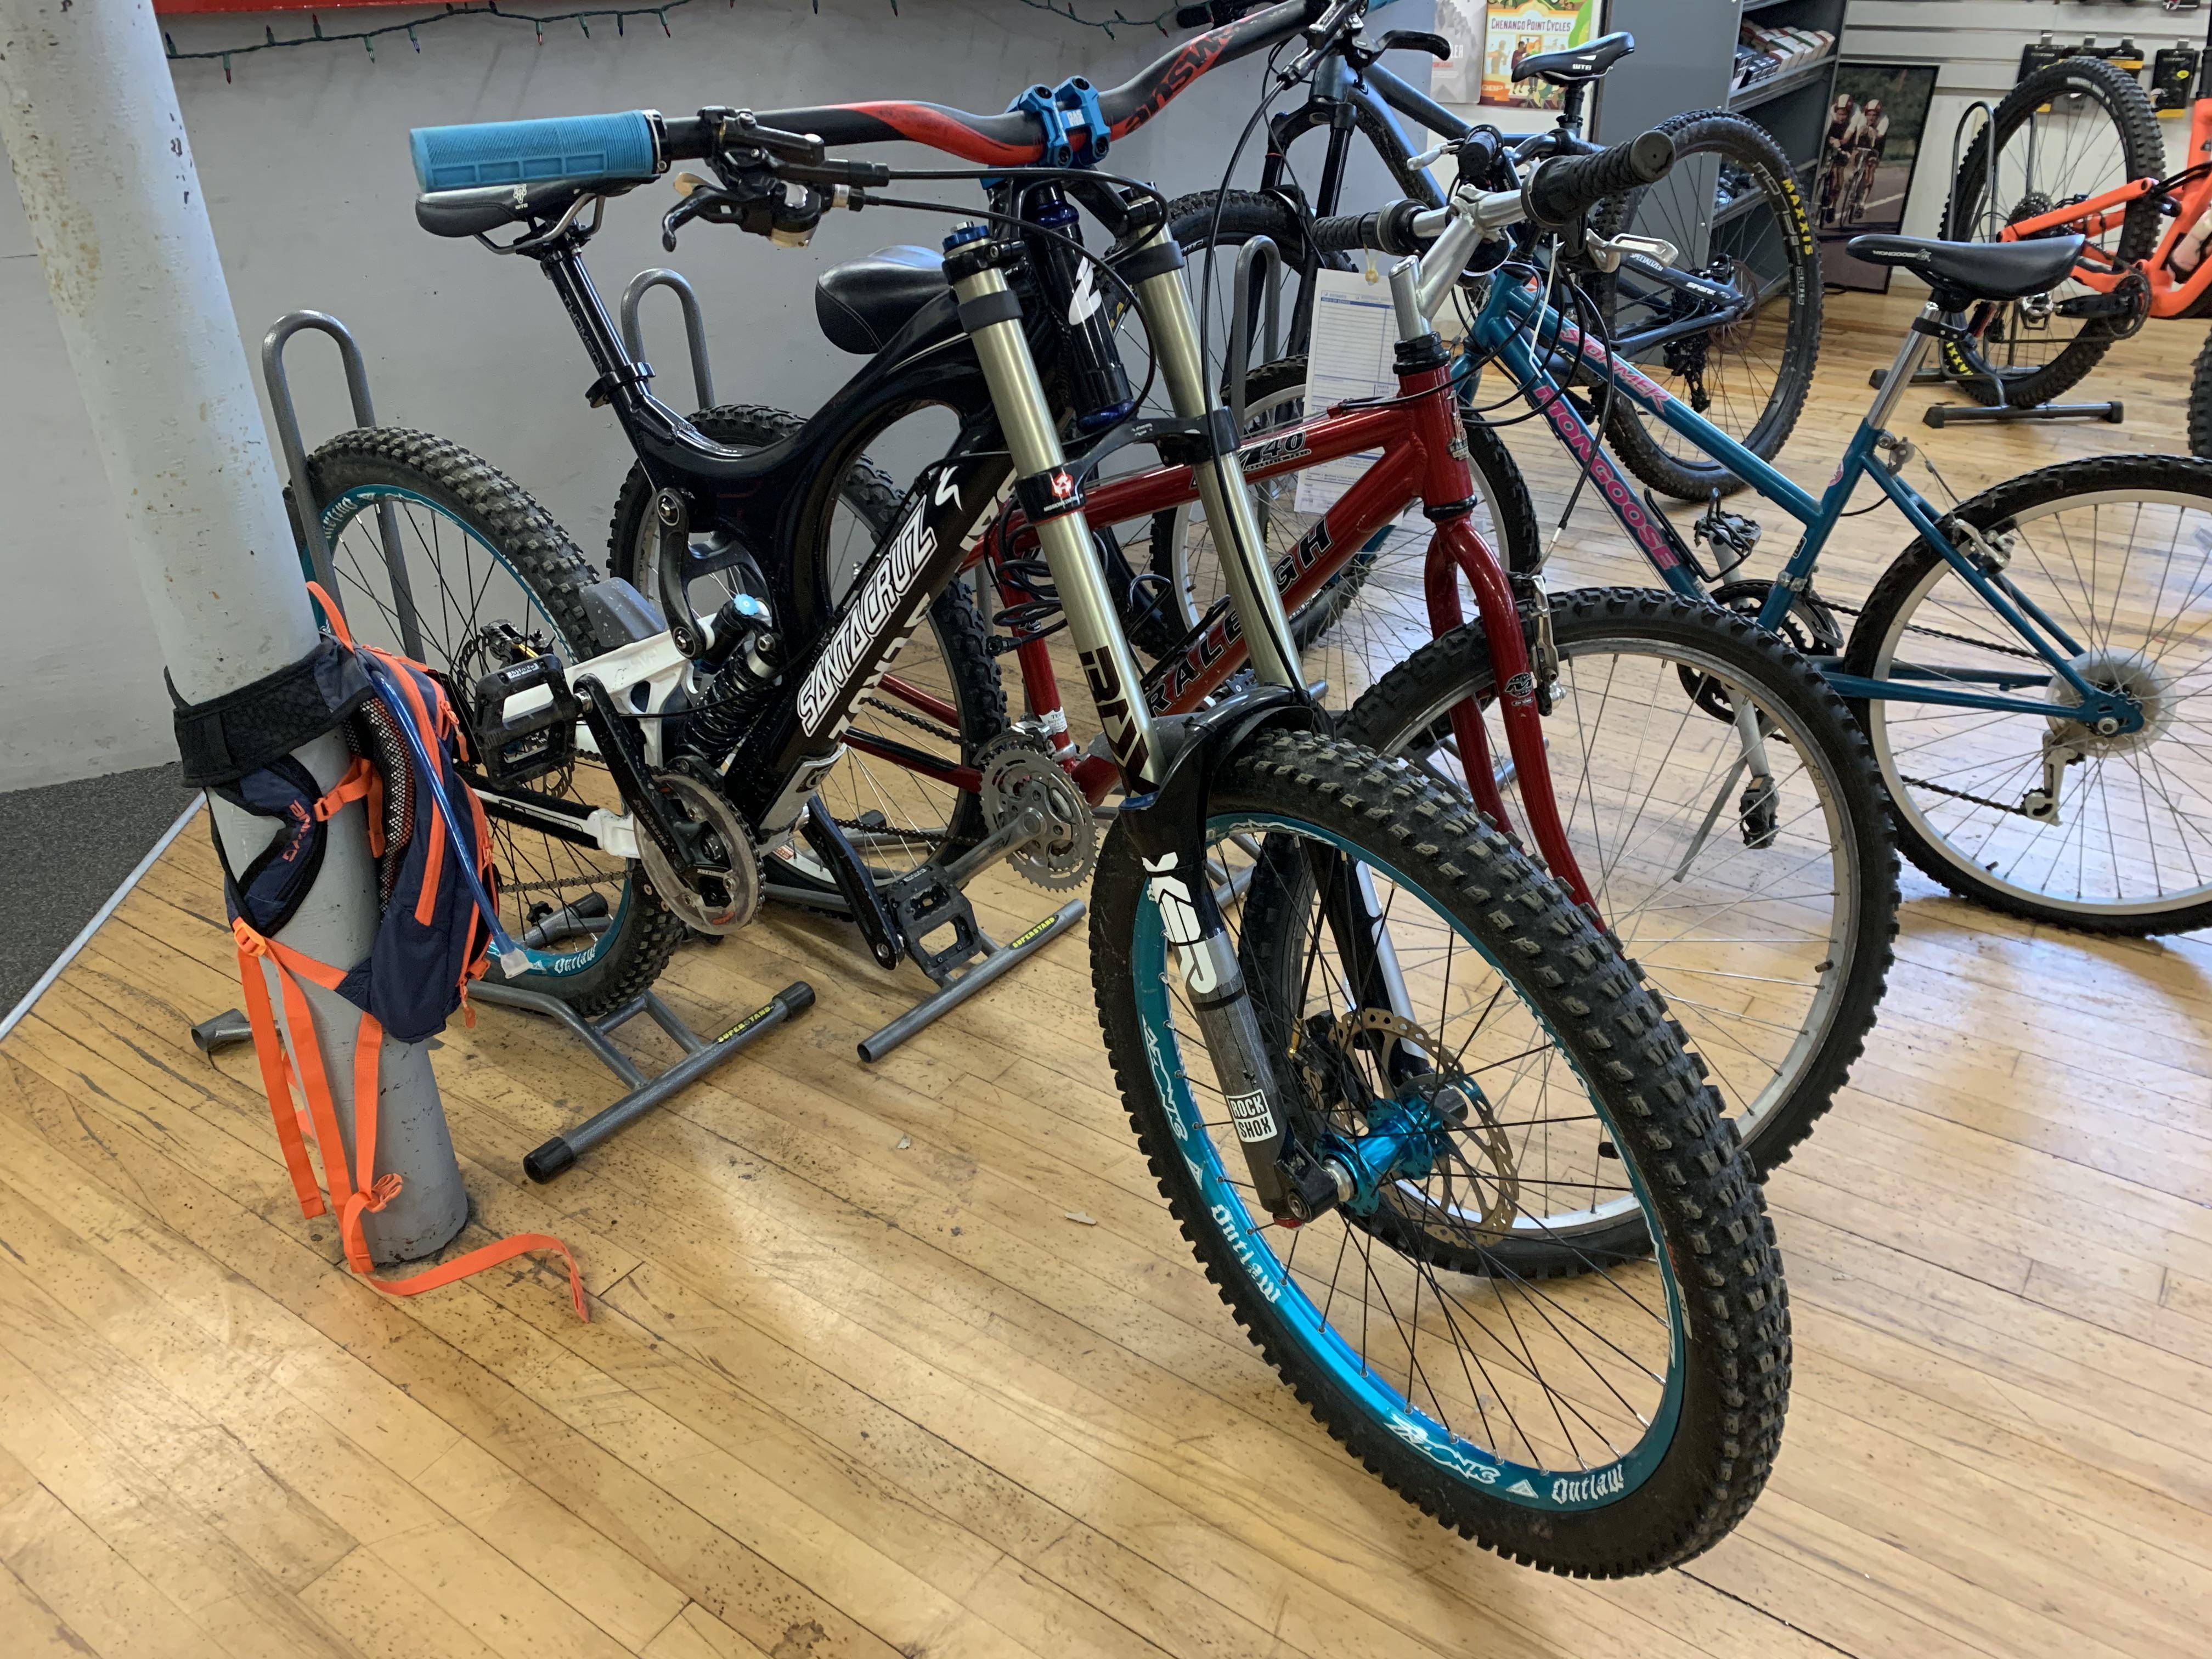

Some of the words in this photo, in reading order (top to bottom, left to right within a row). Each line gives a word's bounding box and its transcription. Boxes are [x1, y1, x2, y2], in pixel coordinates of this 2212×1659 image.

[1491, 18, 1525, 30] CHENANGO
[1527, 19, 1545, 30] POINT
[1547, 20, 1571, 31] CYCLES
[1782, 178, 1814, 255] MAXXIS
[1533, 386, 1680, 570] MONGOOSE
[1146, 515, 1332, 719] RALEGH
[1012, 917, 1055, 949] SUPERSTAND
[554, 943, 596, 974] Outlaw
[718, 1006, 771, 1042] SUPERSTAND
[1230, 1095, 1265, 1118] ROCK
[1238, 1116, 1272, 1138] SHOX
[1211, 1204, 1282, 1304] Outlaw
[1551, 1464, 1624, 1505] Outlaw
